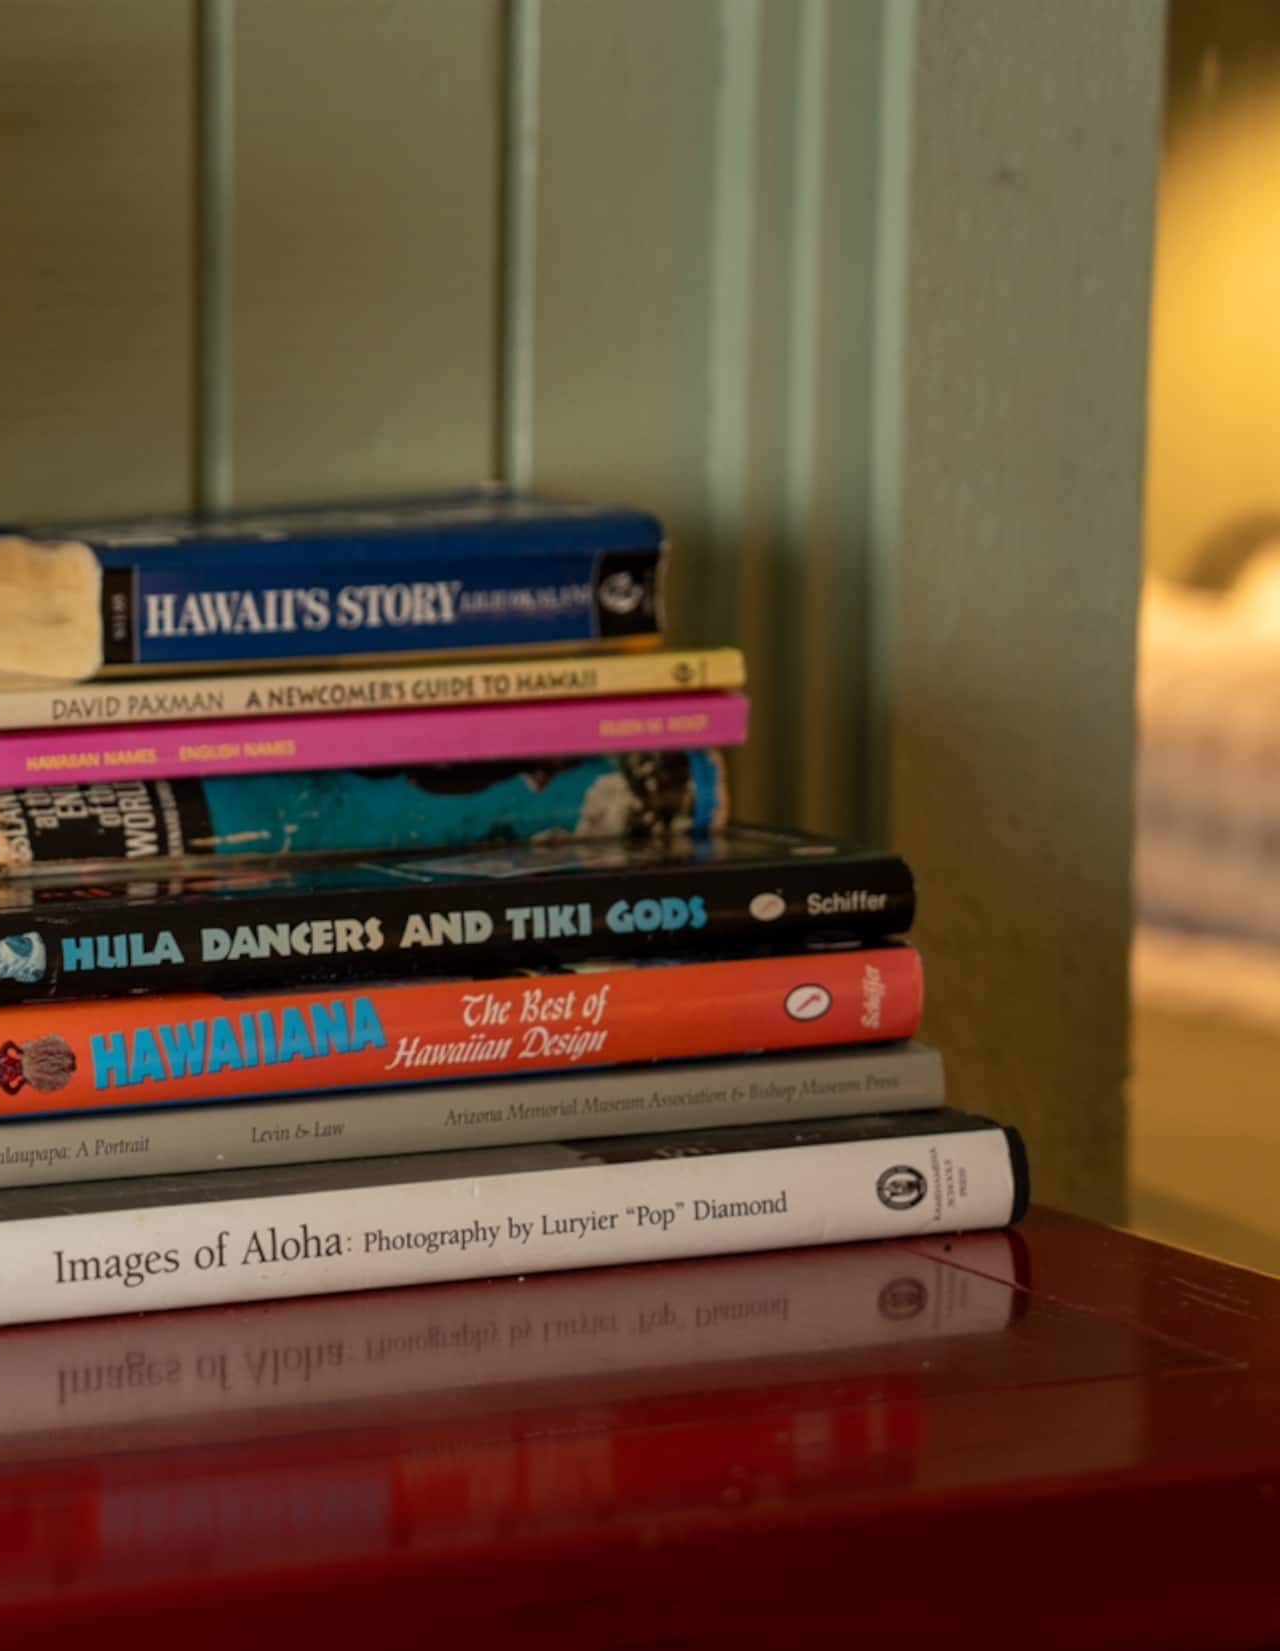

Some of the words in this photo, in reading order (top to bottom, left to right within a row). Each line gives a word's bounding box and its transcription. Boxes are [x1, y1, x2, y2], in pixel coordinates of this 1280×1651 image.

[144, 587, 331, 638] HAWAII'S
[336, 579, 462, 629] STORY
[52, 698, 120, 720] DAVID
[128, 692, 224, 715] PAXMAN
[245, 689, 262, 708] A
[268, 680, 407, 707] NEWCOMER'S
[411, 676, 474, 700] GUIDE
[483, 673, 511, 694] TO
[516, 669, 598, 692] HAWAII
[104, 747, 157, 767] NAMES
[178, 742, 240, 761] ENGLISH
[244, 739, 296, 757] NAMES
[50, 785, 89, 819] EN
[113, 781, 160, 858] WORL
[806, 890, 888, 916] Schiffer
[61, 930, 185, 972] HULA
[201, 917, 385, 963] DANCERS
[399, 910, 494, 948] AND
[505, 902, 593, 941] TIKI
[605, 895, 709, 935] GODS
[460, 991, 512, 1027] The
[520, 988, 576, 1023] Best
[581, 983, 611, 1025] of
[89, 995, 388, 1091] HAWAIIANA
[384, 1033, 513, 1071] Hawaiian
[517, 1025, 609, 1061] Design
[444, 1108, 503, 1127] Arizona
[506, 1100, 577, 1121] Memorial
[581, 1096, 644, 1114] Museum
[647, 1088, 727, 1110] Association
[730, 1086, 746, 1102] &
[749, 1082, 796, 1104] Bishop
[799, 1077, 861, 1097] Museum
[865, 1074, 900, 1092] Press
[75, 1140, 90, 1158] A
[95, 1136, 151, 1156] Portrait
[251, 1126, 290, 1144] Levin
[294, 1125, 310, 1141] &
[314, 1121, 345, 1140] Law
[53, 1245, 180, 1288] Images
[194, 1231, 230, 1268] of
[240, 1224, 353, 1265] Aloha:
[363, 1222, 501, 1255] Photography
[507, 1216, 535, 1244] by
[541, 1213, 619, 1239] Luryier
[693, 1191, 788, 1221] Diamond
